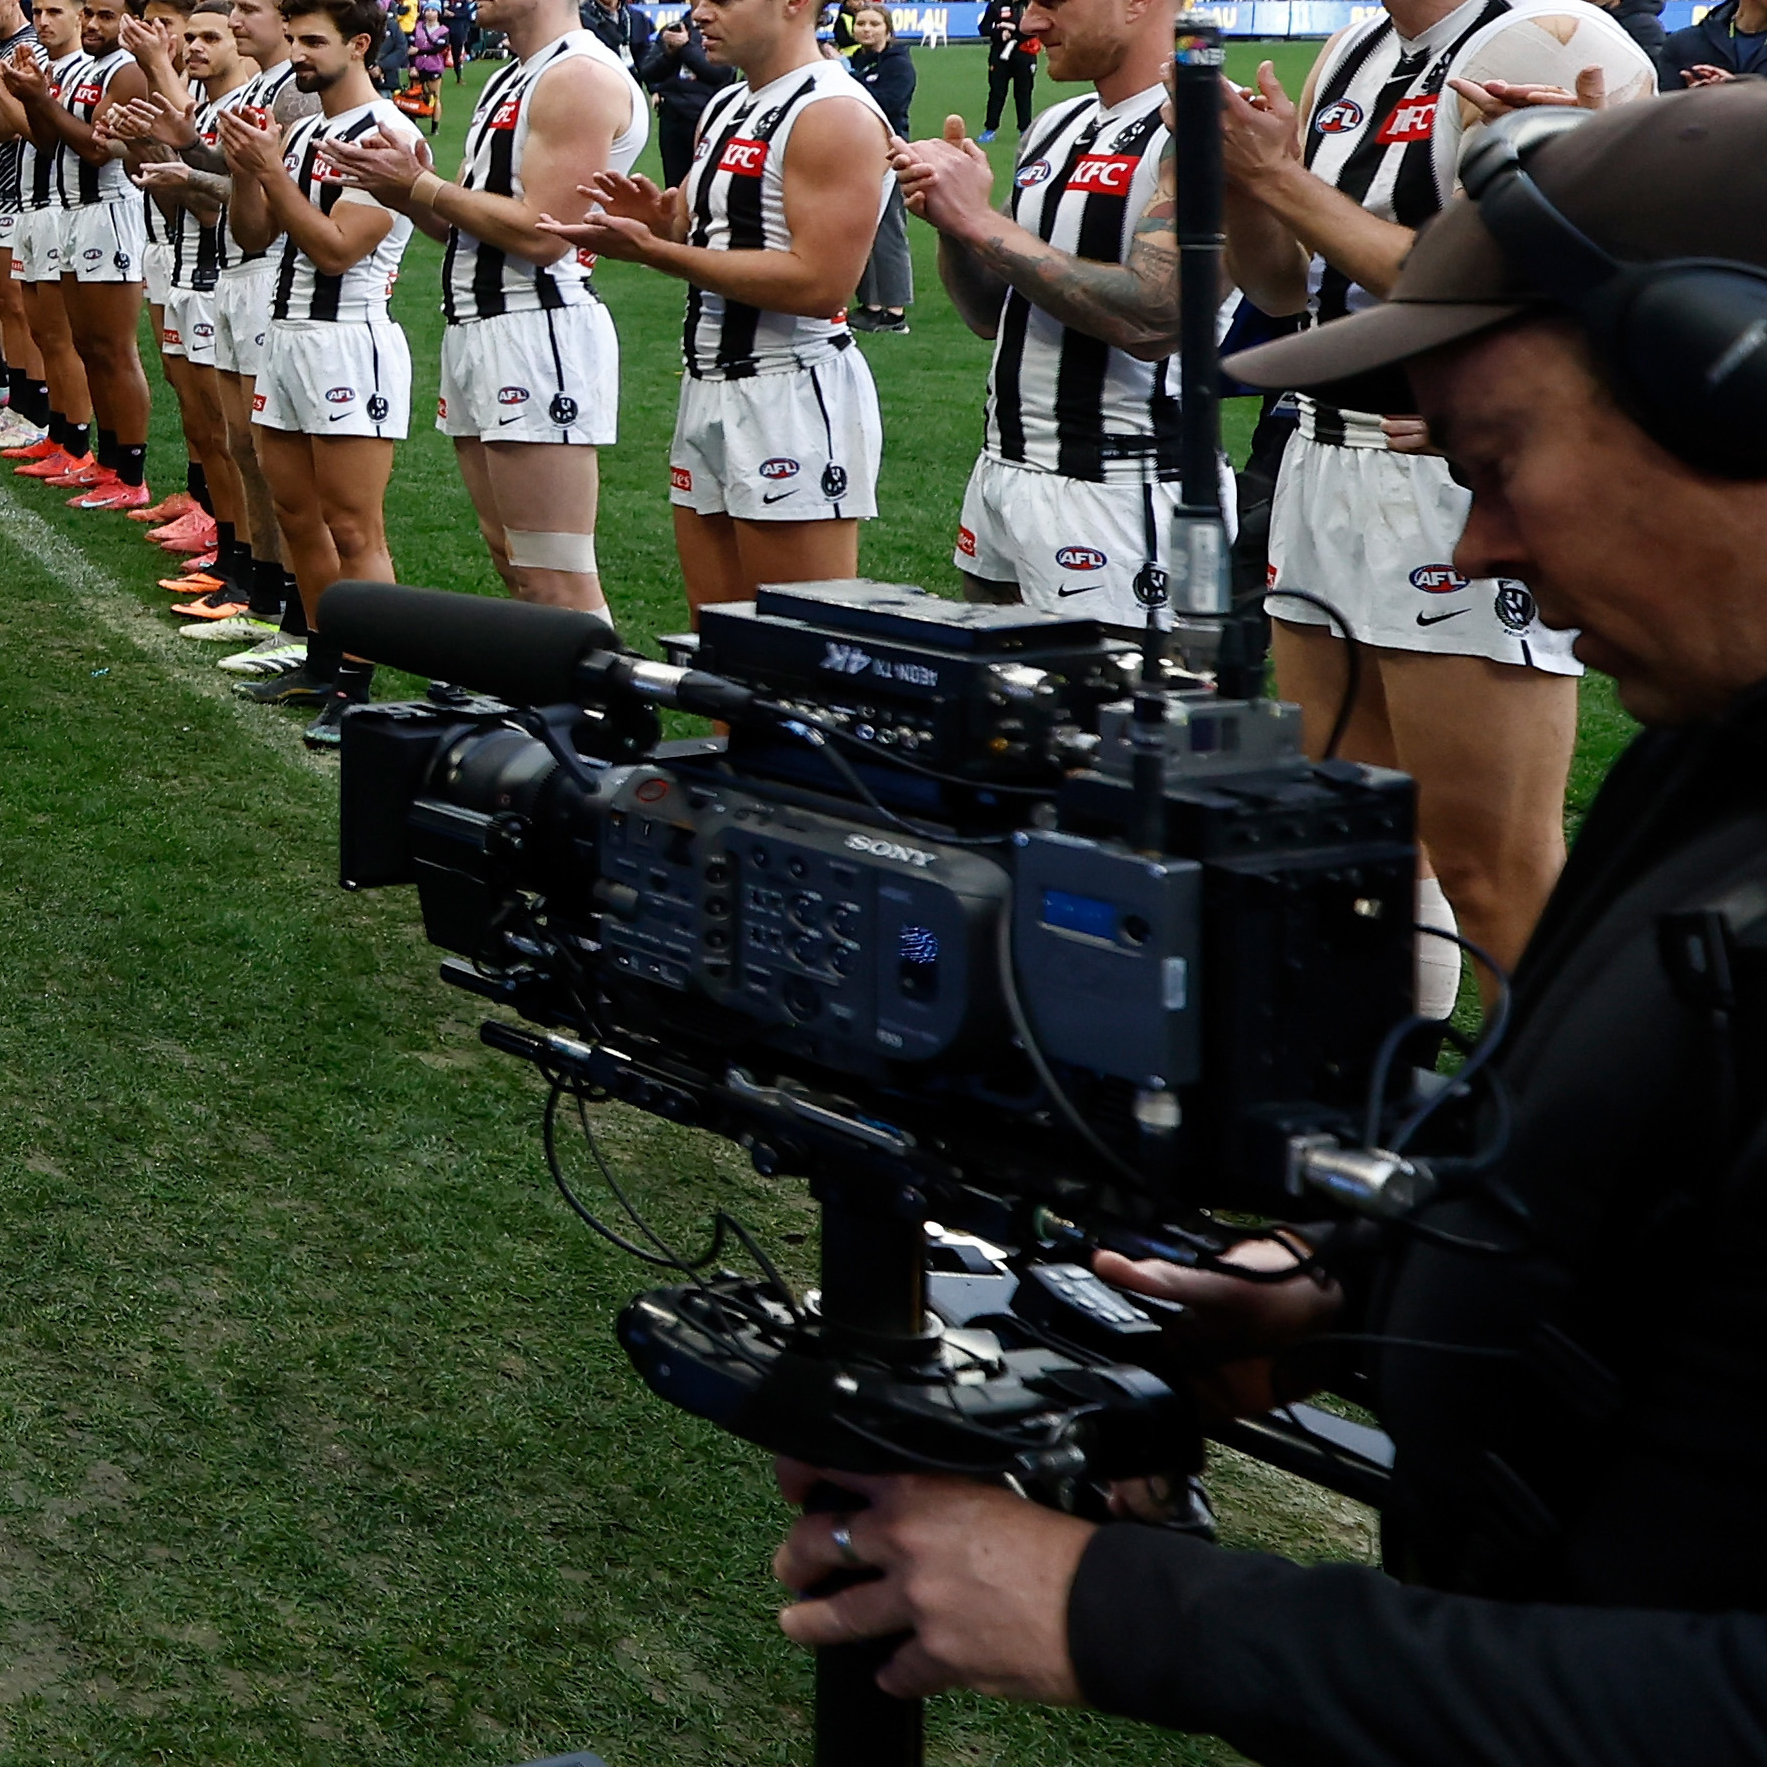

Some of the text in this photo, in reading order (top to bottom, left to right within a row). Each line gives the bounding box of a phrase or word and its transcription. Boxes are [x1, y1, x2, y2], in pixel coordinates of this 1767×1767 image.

[74, 86, 100, 104] KFC
[1315, 106, 1361, 129] AFL
[722, 143, 761, 168] KFC
[1017, 164, 1050, 185] AFL
[1073, 161, 1128, 186] KFC
[84, 250, 103, 260] AFL
[195, 323, 215, 335] AFL
[327, 389, 355, 401] AFL
[499, 390, 527, 401] AFL
[763, 461, 797, 475] AFL
[1059, 551, 1104, 565] AFL
[1414, 570, 1466, 587] AFL
[843, 833, 939, 867] SONY
